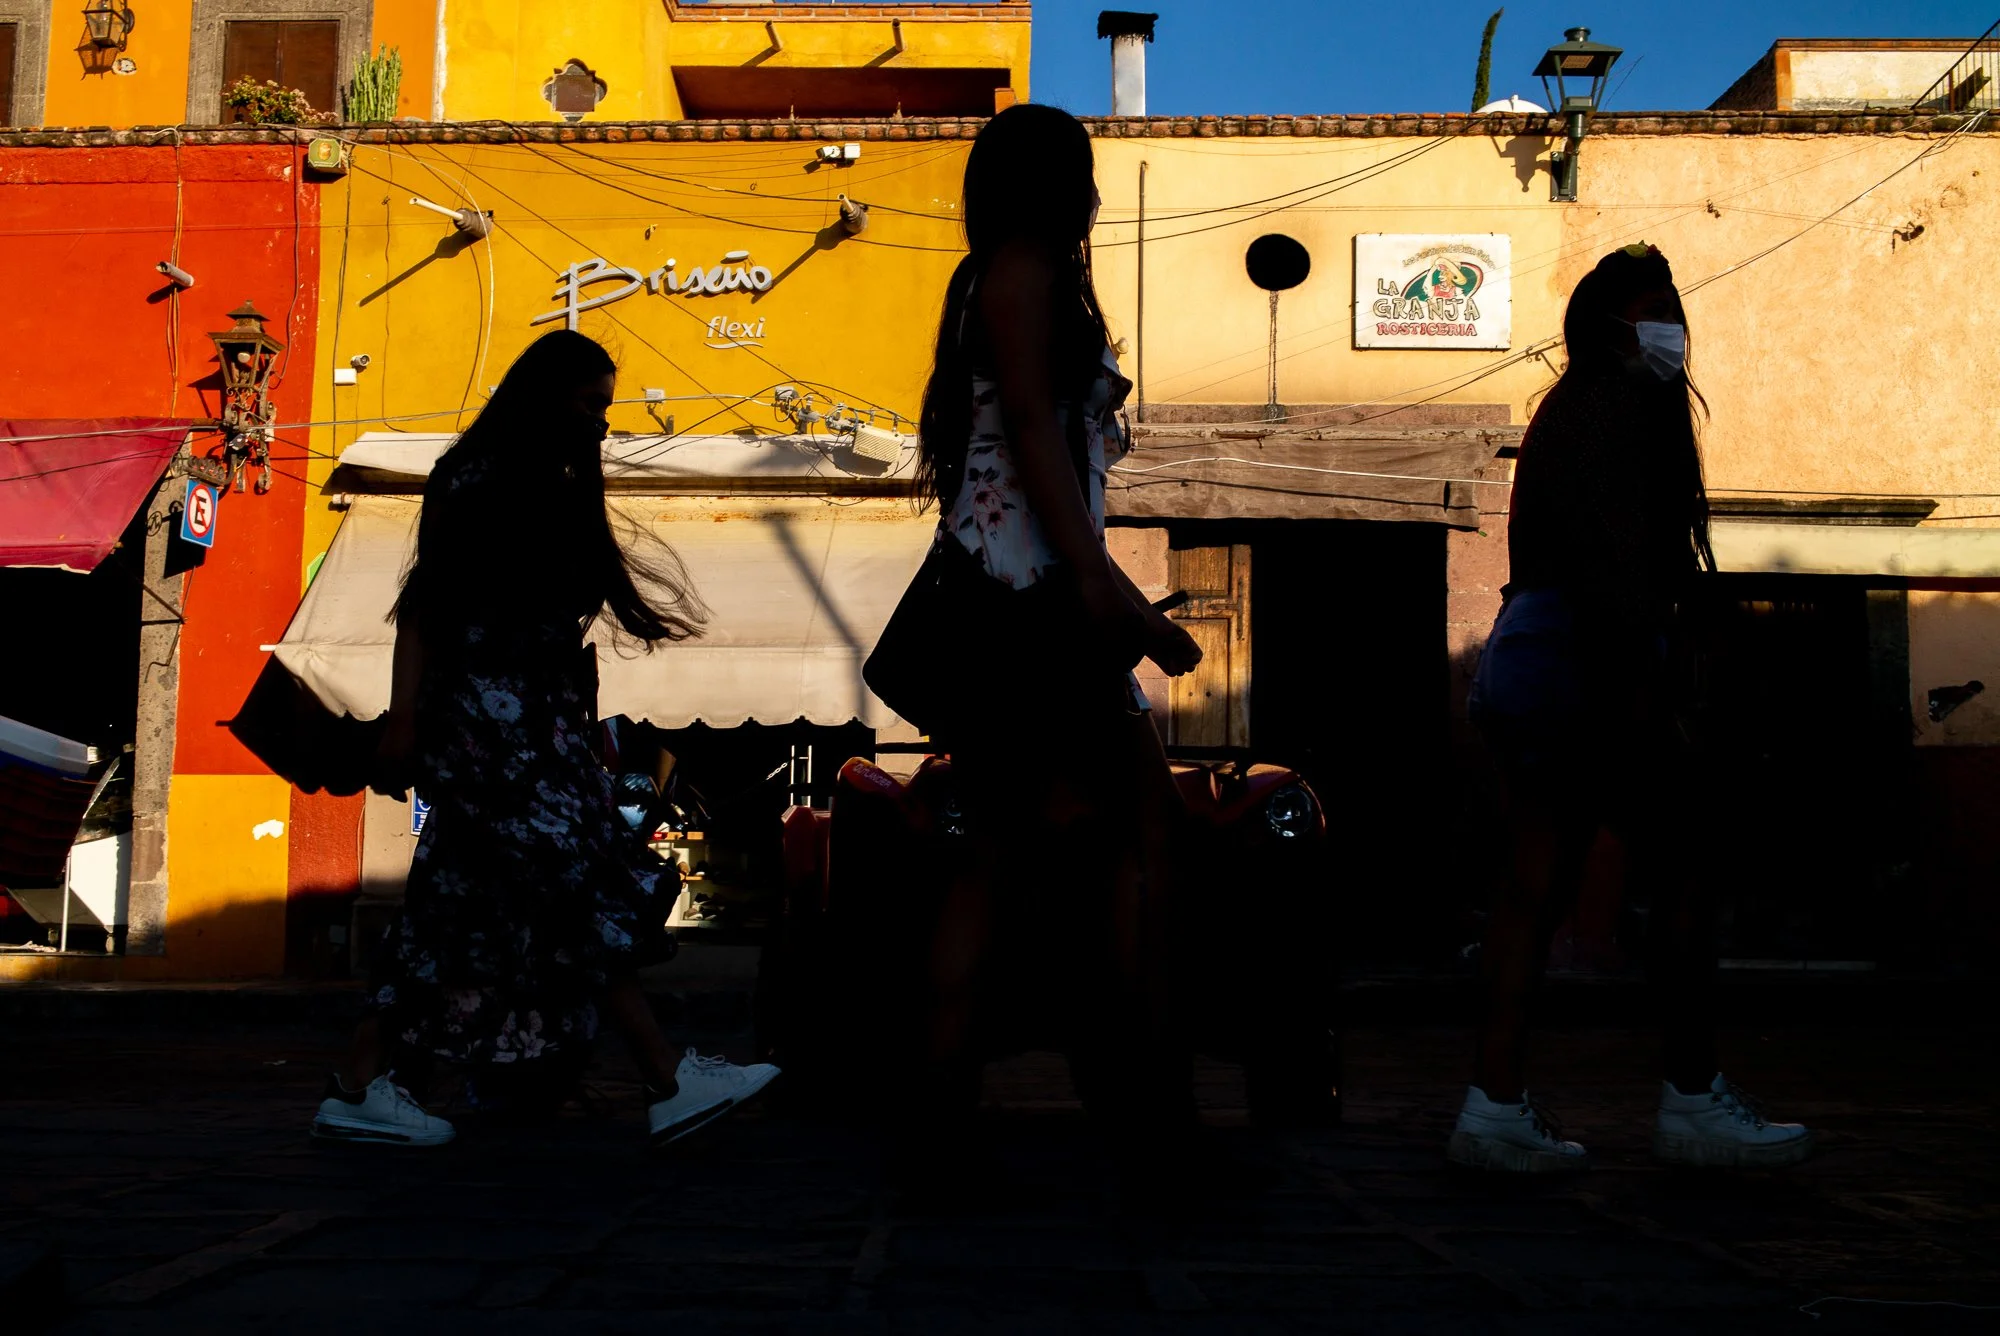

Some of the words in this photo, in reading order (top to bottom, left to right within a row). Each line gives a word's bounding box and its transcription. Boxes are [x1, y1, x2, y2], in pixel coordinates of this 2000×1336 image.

[1377, 278, 1399, 296] LA
[1373, 298, 1480, 321] GRANJA
[706, 316, 767, 338] flexi
[1376, 323, 1477, 336] ROSTICERIA
